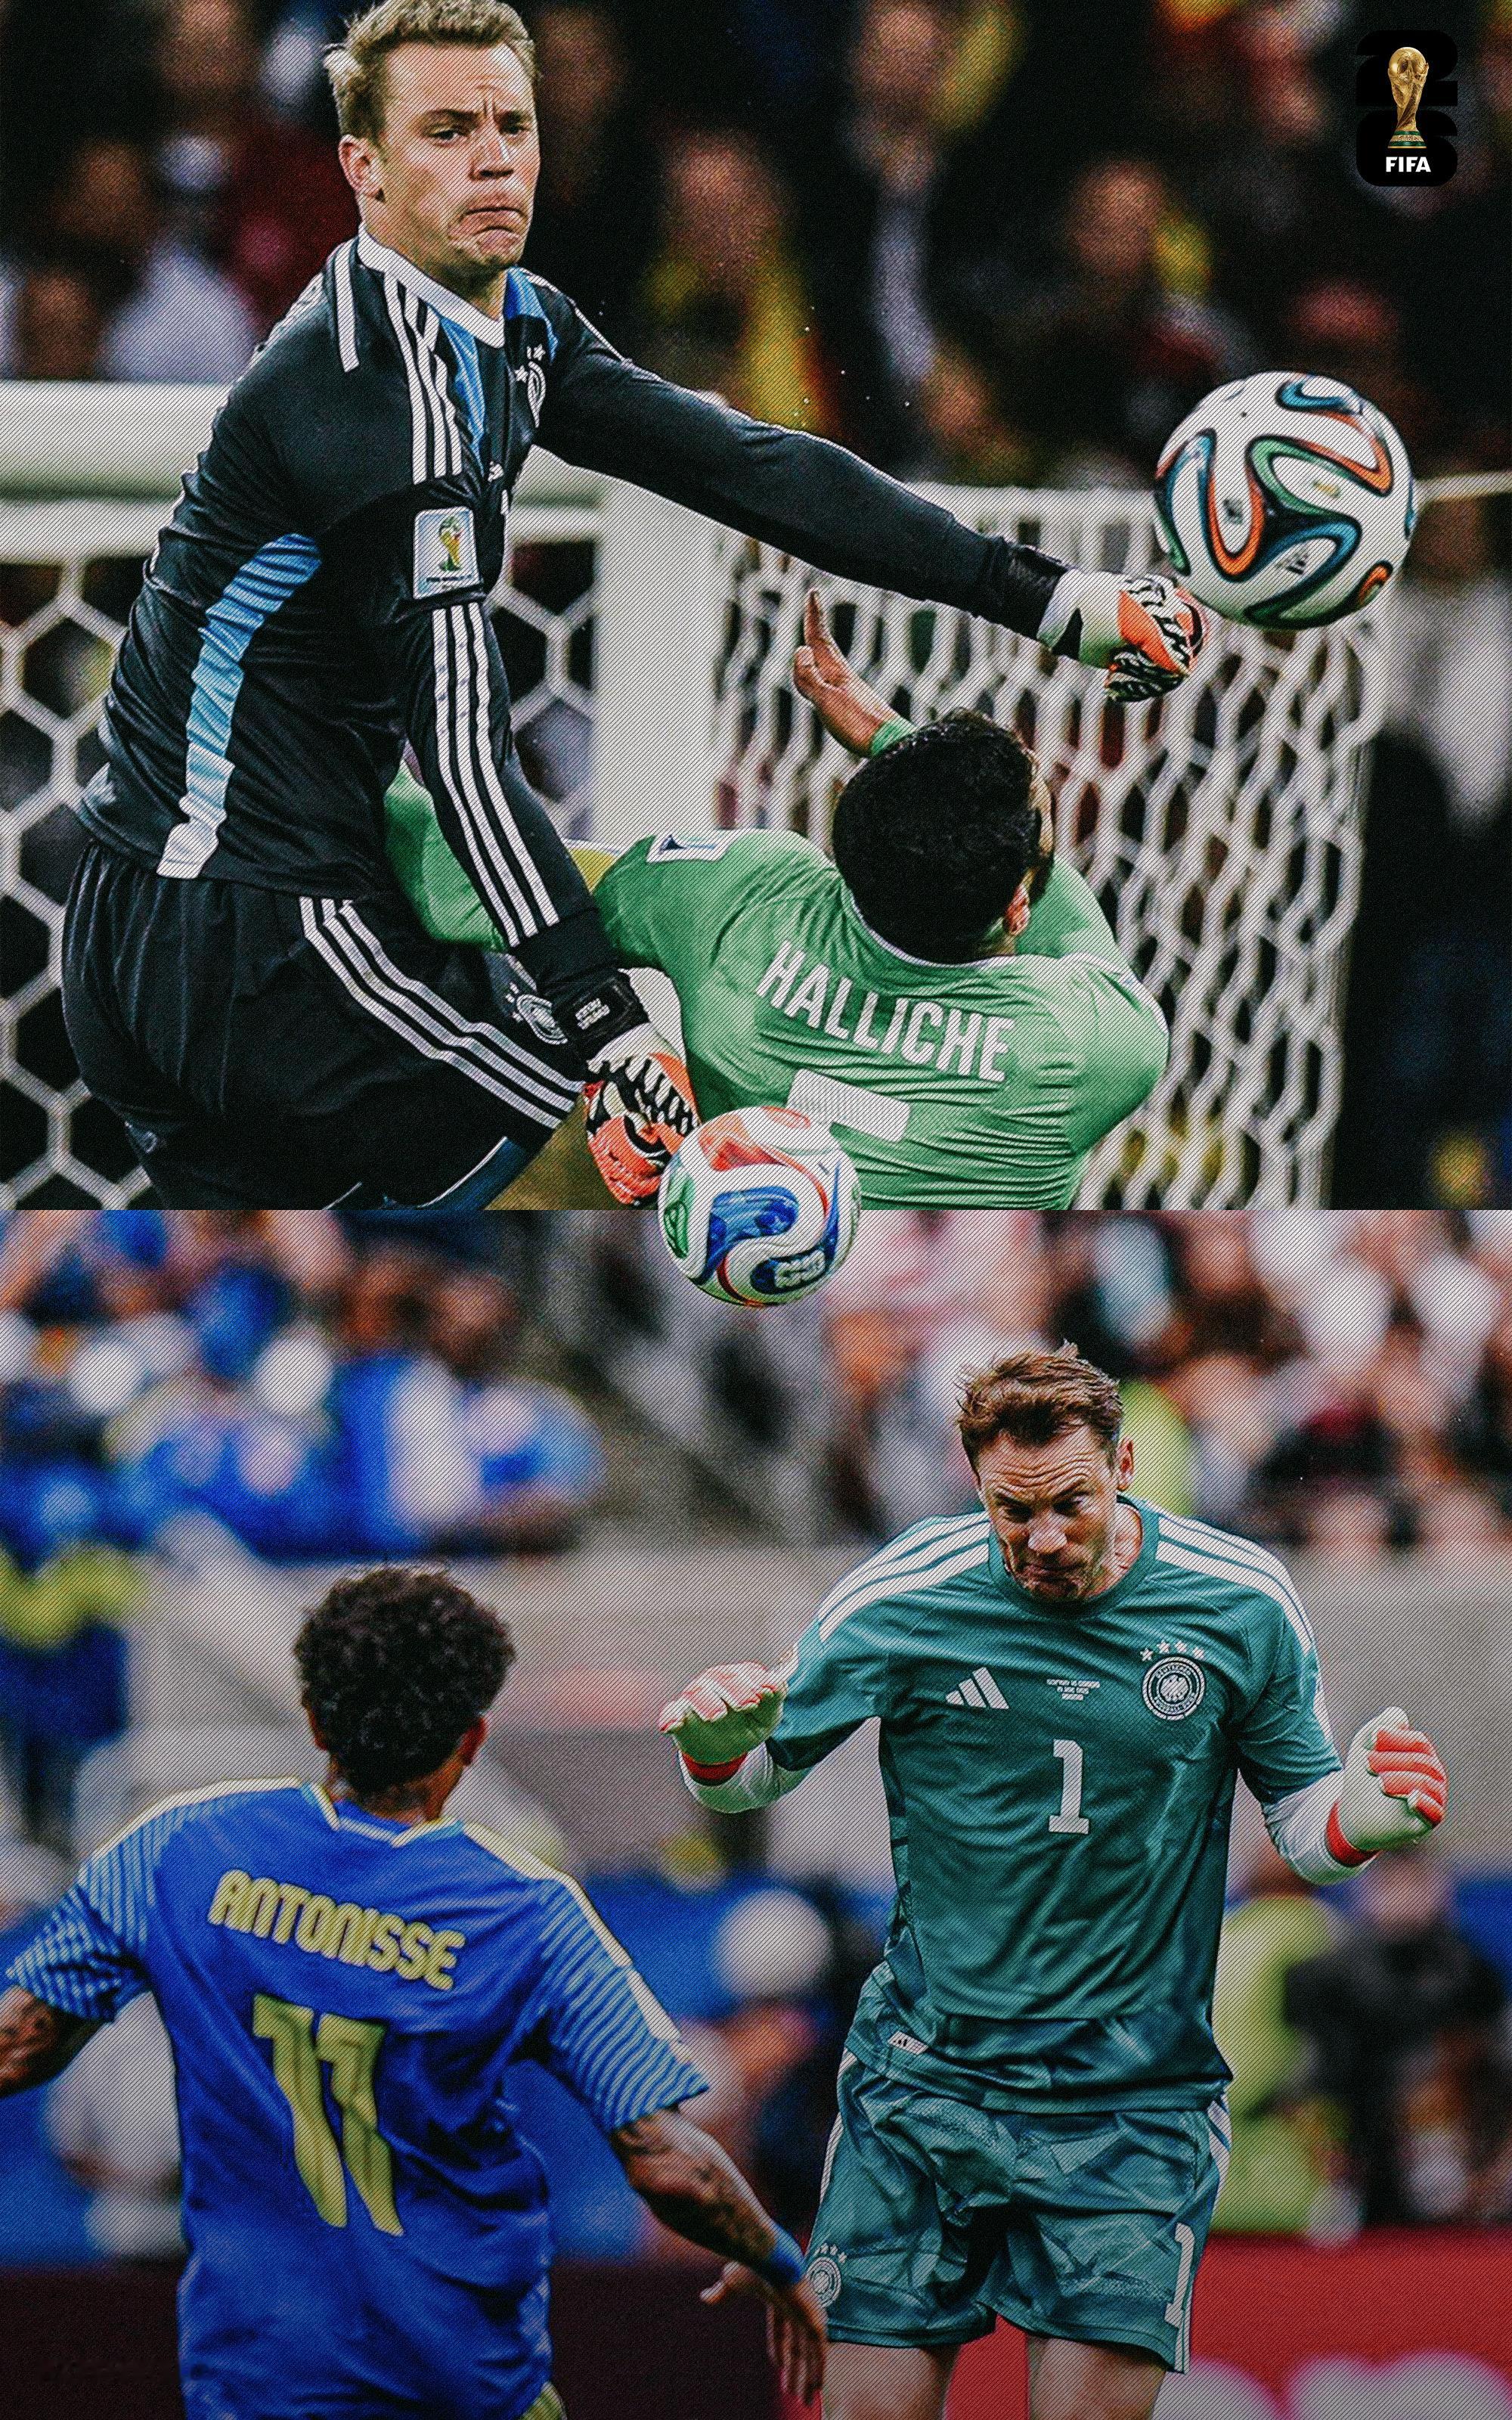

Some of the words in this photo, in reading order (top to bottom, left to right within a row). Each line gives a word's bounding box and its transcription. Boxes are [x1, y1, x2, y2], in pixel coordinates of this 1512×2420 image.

[755, 939, 1016, 1083] HALLICHE
[1048, 1739, 1090, 1835] 1
[207, 1869, 466, 1991] ANTONISSE
[1164, 2221, 1195, 2329] 1
